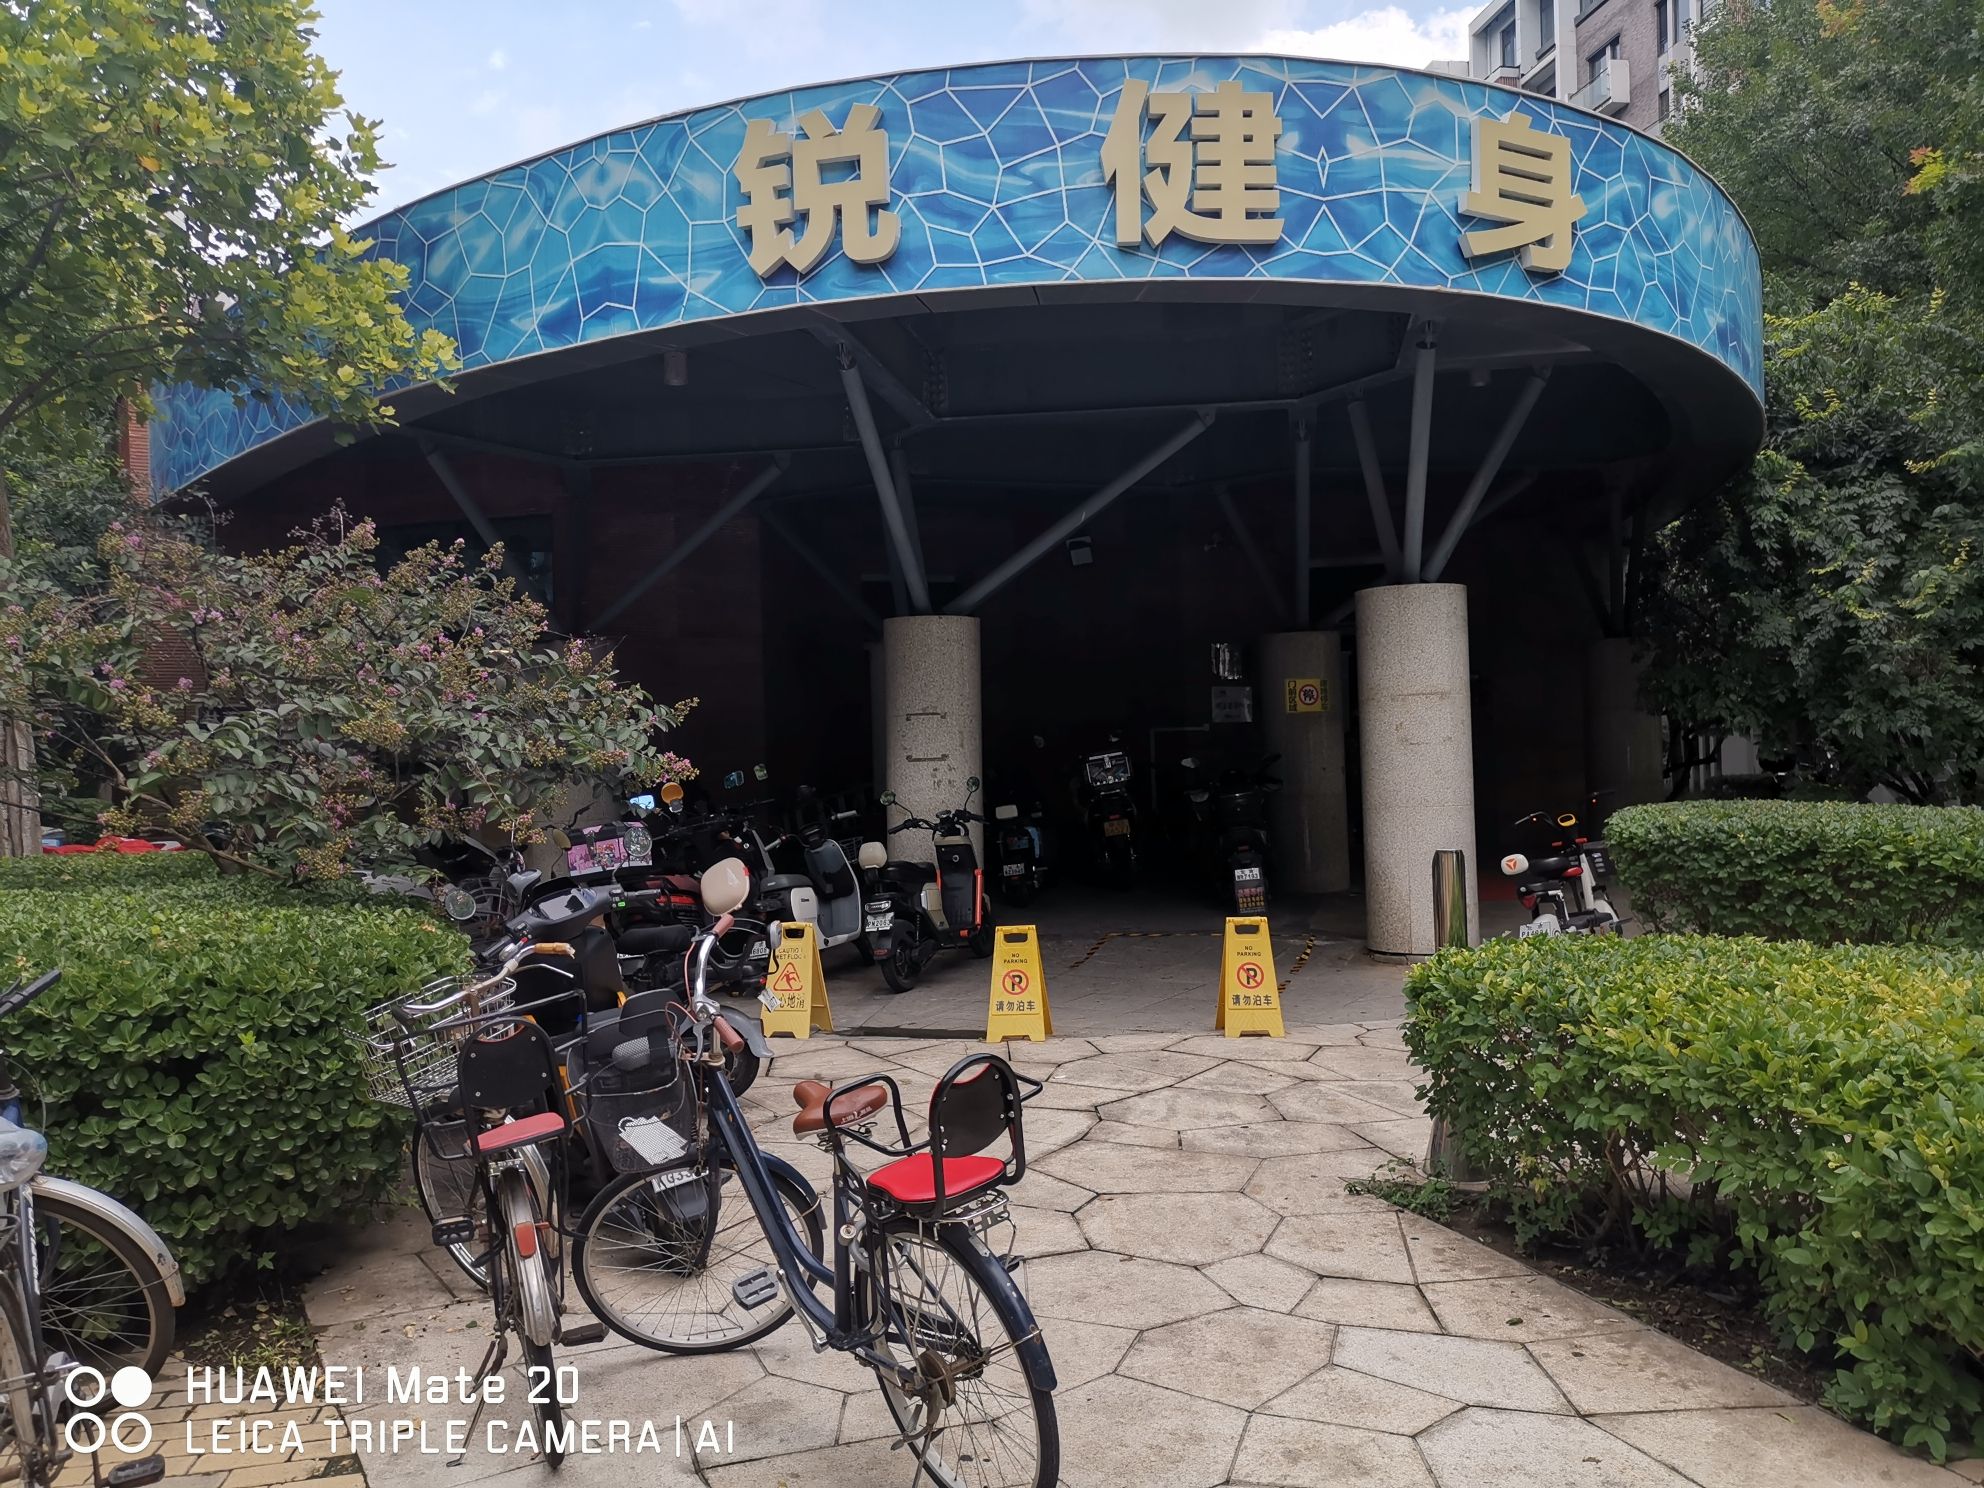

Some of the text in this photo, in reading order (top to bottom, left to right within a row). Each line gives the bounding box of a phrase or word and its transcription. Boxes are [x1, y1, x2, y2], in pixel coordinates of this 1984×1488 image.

[736, 79, 1588, 275] 锐健身
[995, 1000, 1036, 1012] 请勿泊车
[1231, 994, 1273, 1006] 请勿泊车
